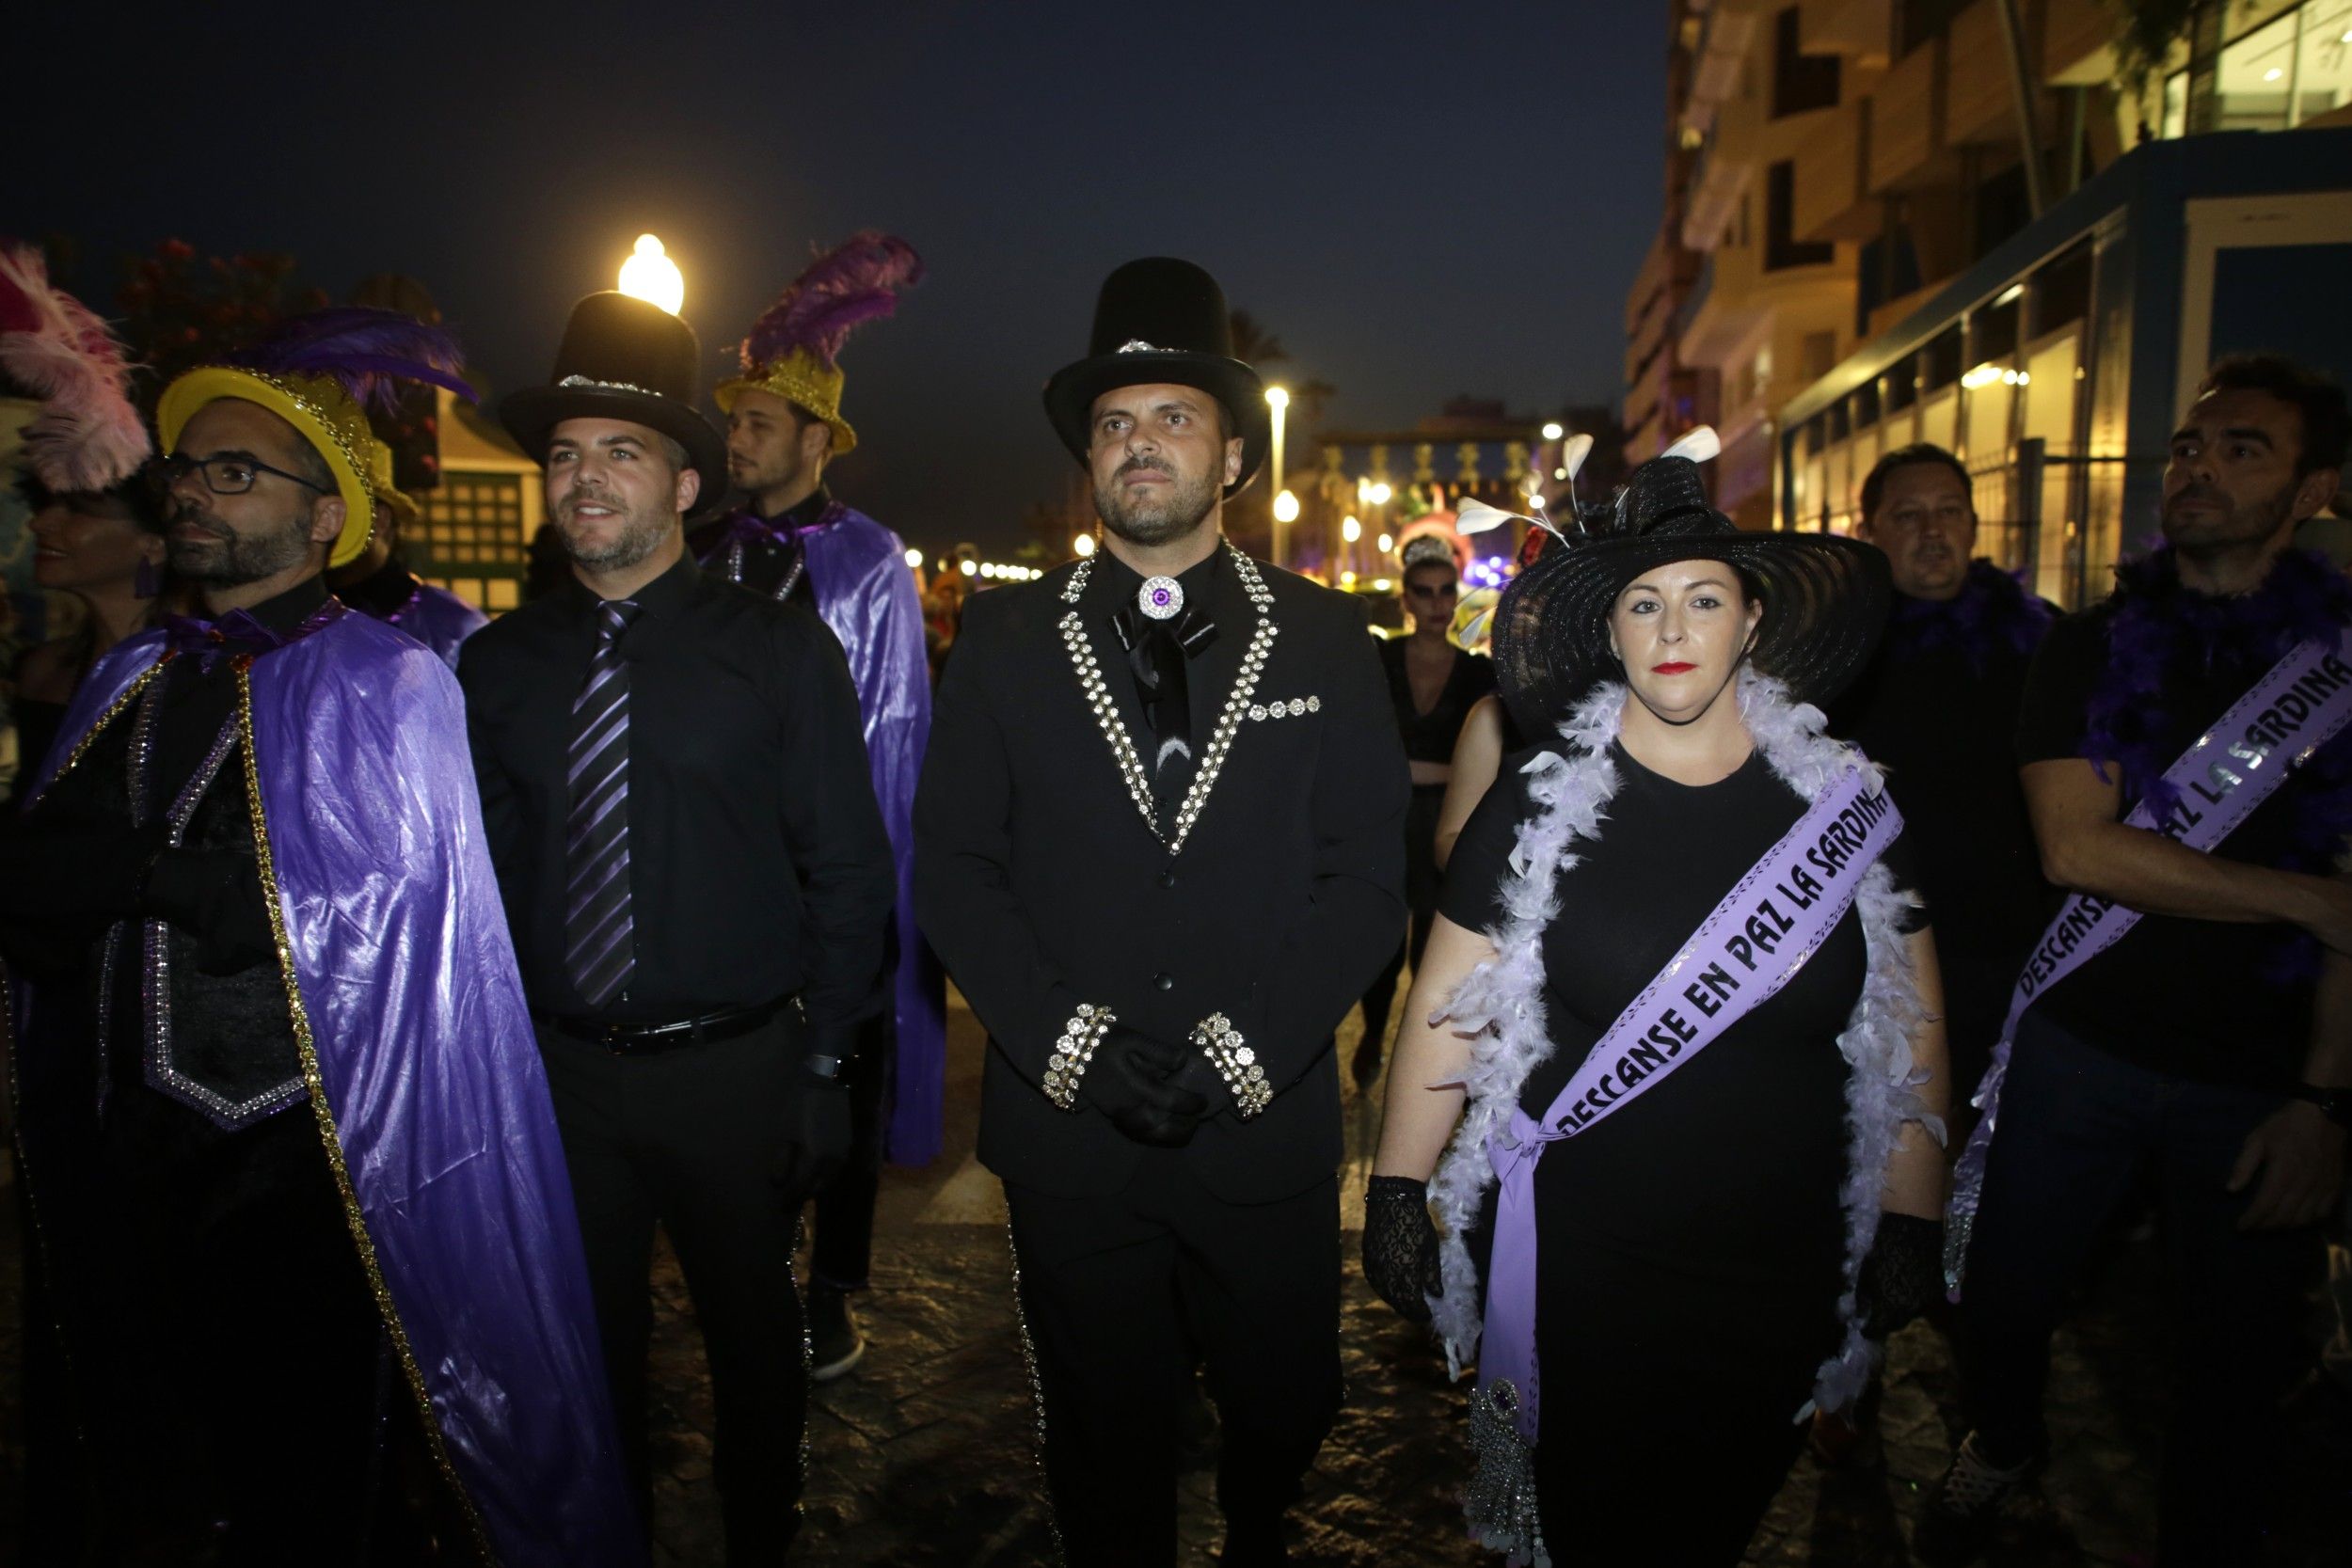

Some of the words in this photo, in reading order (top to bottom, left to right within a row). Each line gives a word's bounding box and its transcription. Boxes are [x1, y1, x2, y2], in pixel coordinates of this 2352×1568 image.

[2189, 760, 2243, 805] LA
[2228, 654, 2352, 770] SARDINA
[1683, 961, 1740, 1018] EN
[1724, 899, 1794, 971] PAZ
[1776, 863, 1824, 910] LA
